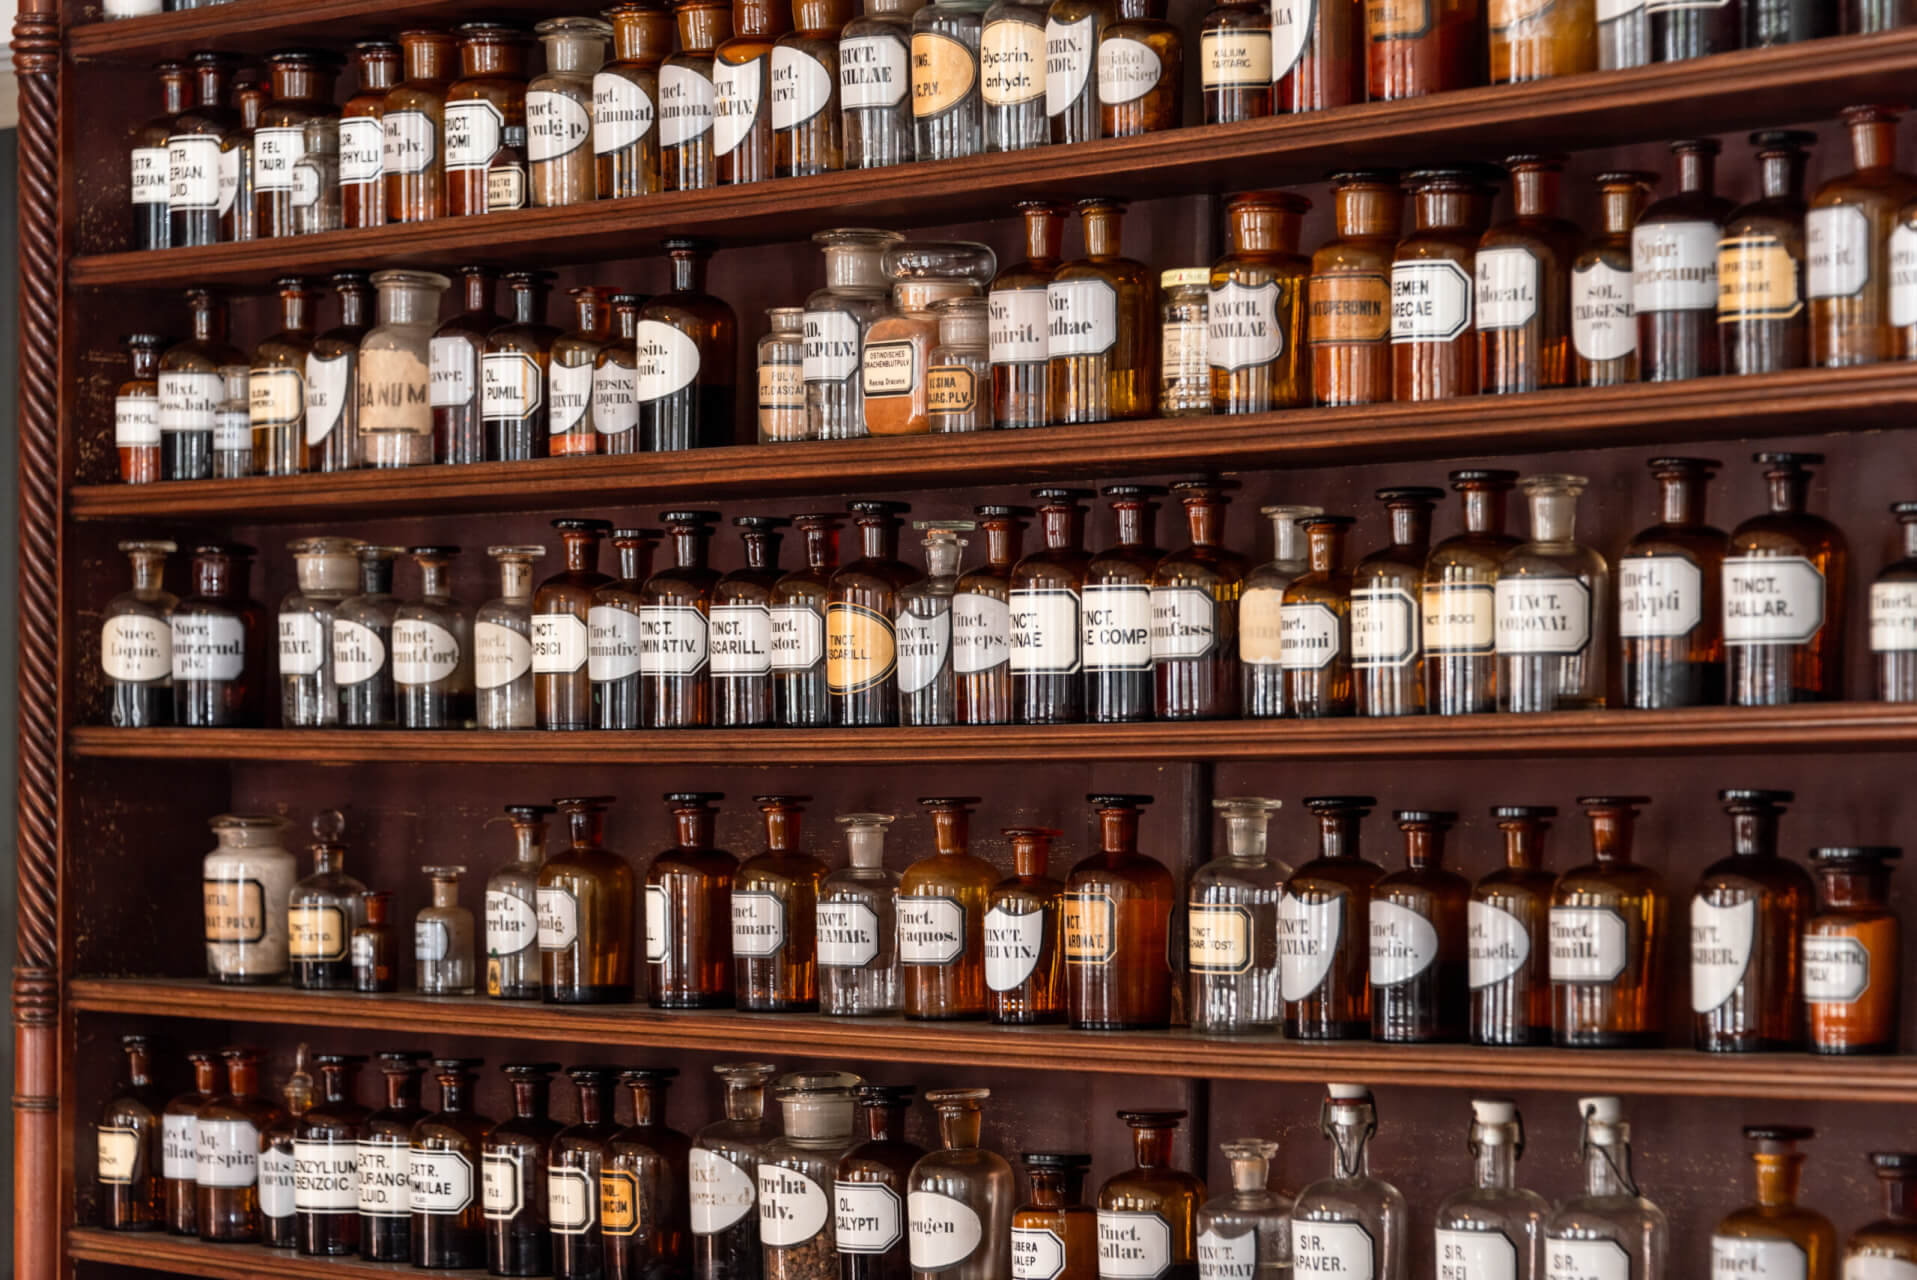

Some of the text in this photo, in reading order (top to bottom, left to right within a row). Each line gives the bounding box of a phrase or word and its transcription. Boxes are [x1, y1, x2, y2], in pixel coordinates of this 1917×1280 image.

[986, 75, 1032, 92] anhydr.
[1100, 628, 1147, 646] COMP.
[1300, 1234, 1325, 1252] SIR.
